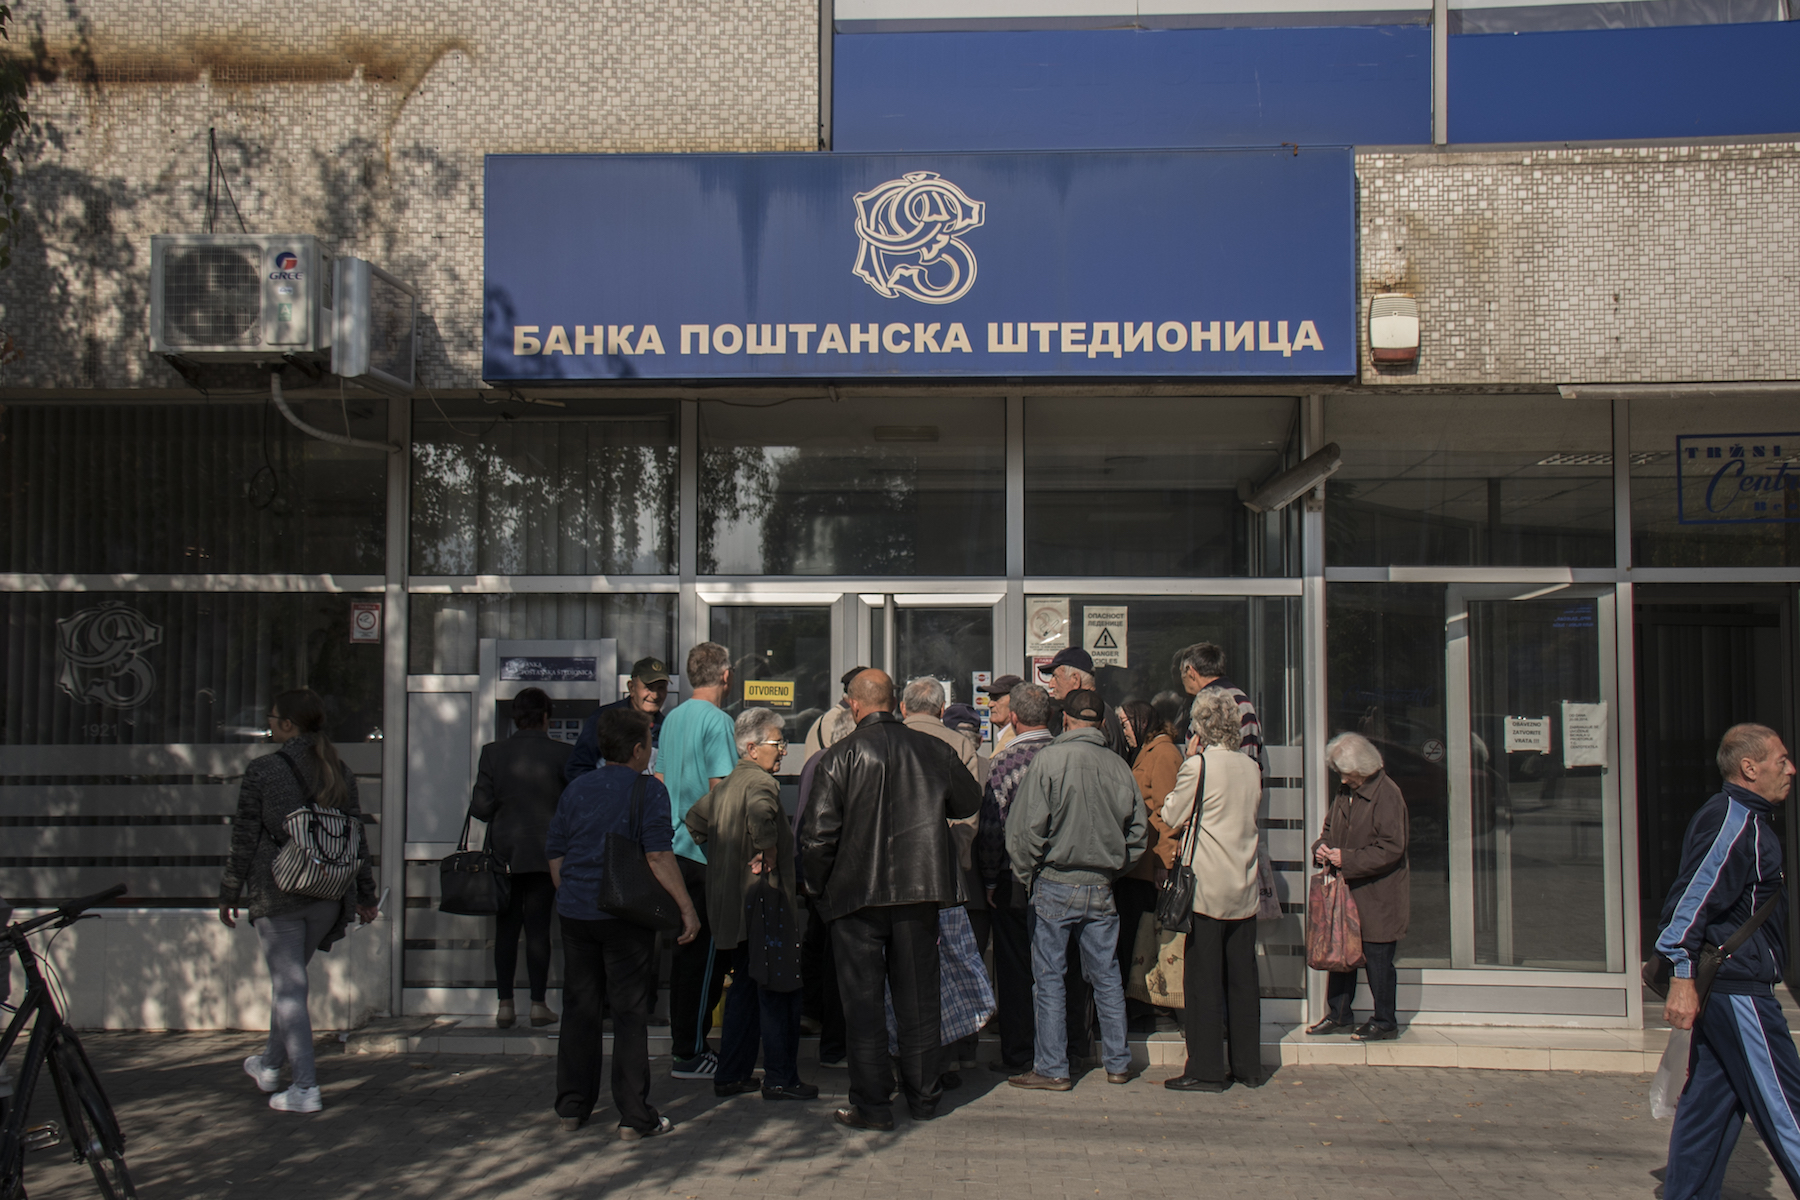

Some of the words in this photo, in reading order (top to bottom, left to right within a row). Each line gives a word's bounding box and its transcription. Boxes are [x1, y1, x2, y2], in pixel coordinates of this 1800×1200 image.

[269, 271, 303, 280] GREE
[513, 324, 665, 356] БАНКА
[680, 323, 972, 355] ПОШТАНСКА
[988, 320, 1325, 359] ШТЕДИОНИЦА
[749, 685, 789, 696] OTVORENO
[82, 723, 118, 737] 1921
